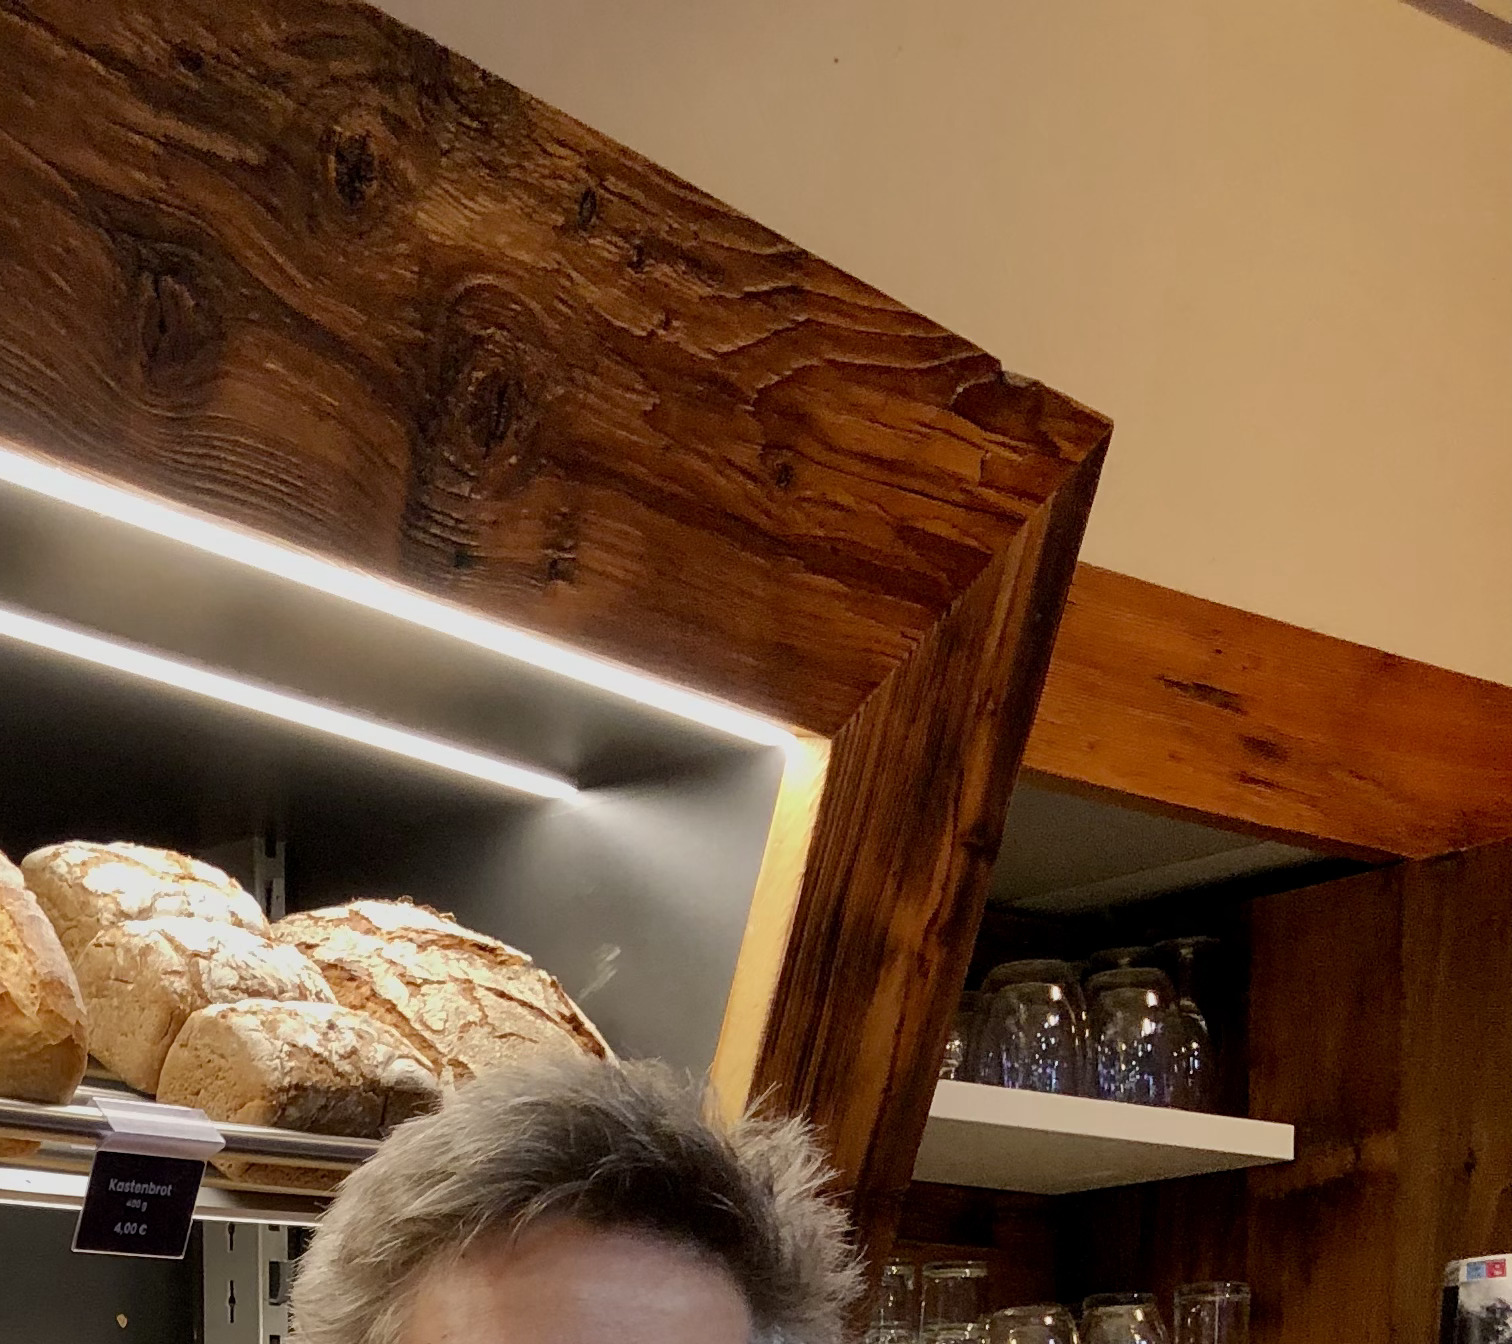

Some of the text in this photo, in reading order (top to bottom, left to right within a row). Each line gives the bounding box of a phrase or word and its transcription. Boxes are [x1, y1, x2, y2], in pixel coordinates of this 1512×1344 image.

[108, 1178, 172, 1196] Kastenbrot
[114, 1222, 148, 1235] 4,00 €
